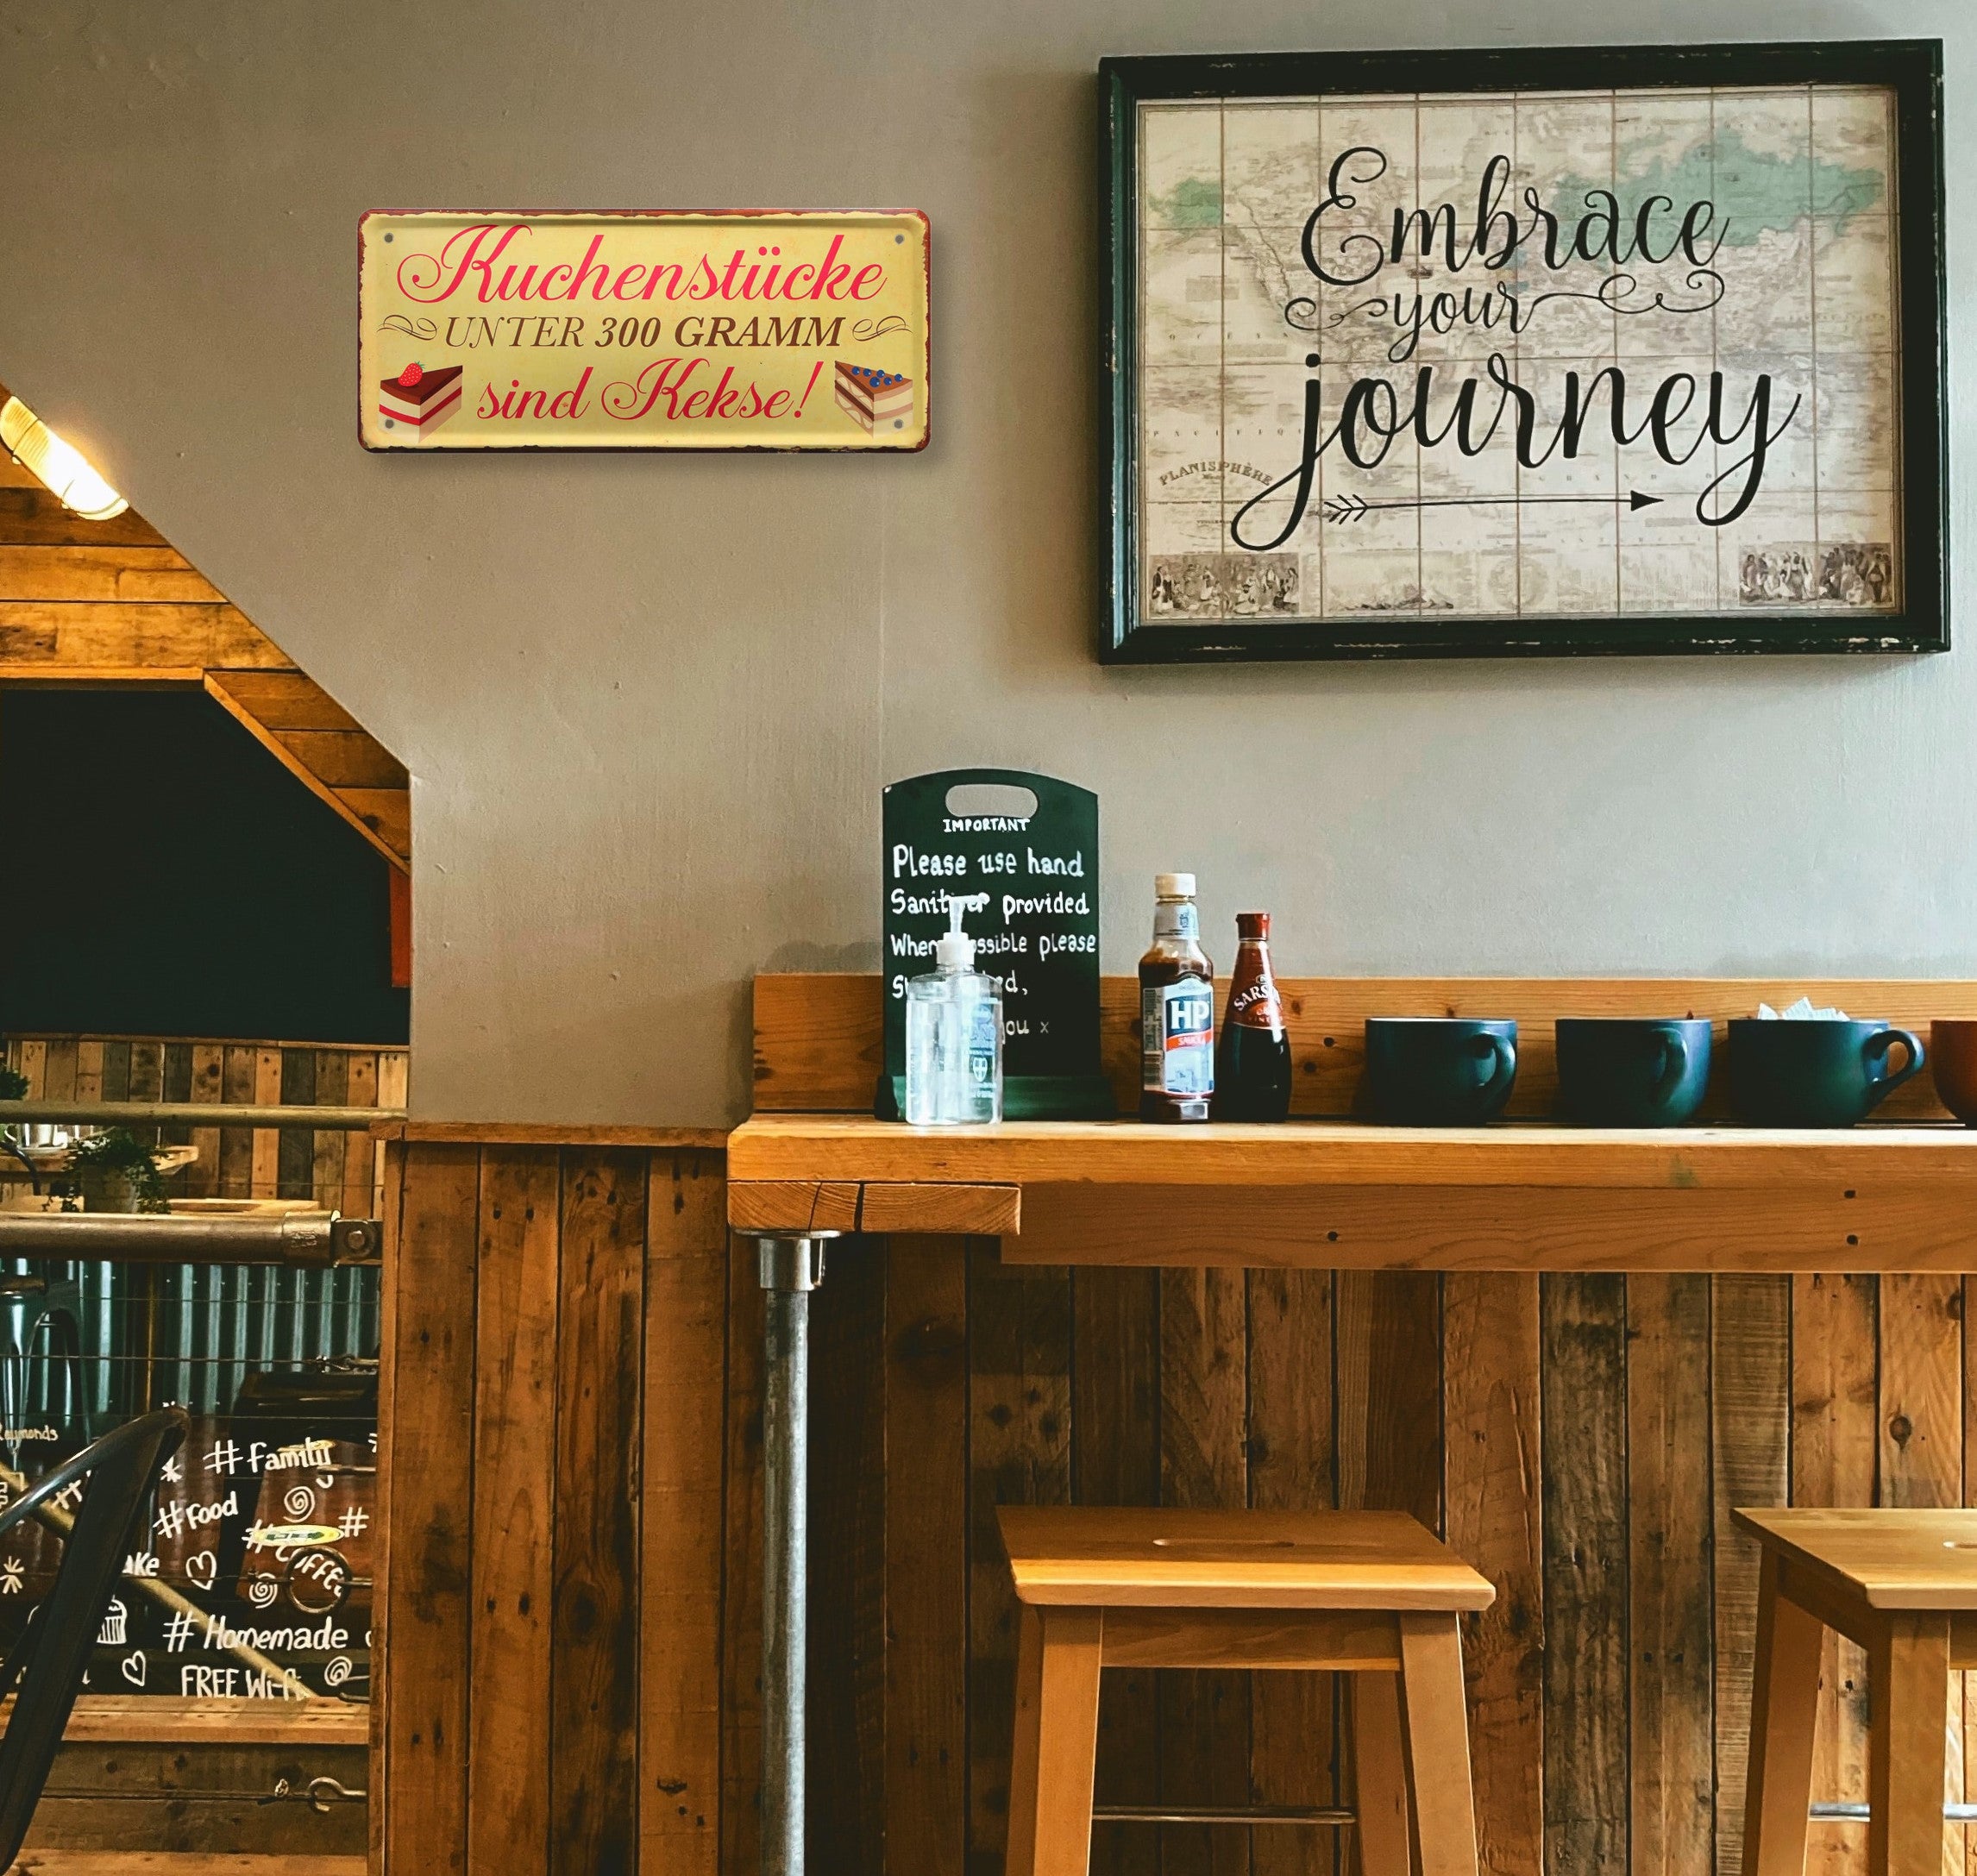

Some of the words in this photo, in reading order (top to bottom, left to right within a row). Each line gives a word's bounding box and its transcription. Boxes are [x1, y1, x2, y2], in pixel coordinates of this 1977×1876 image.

[1301, 146, 1730, 286] Embrace
[396, 224, 888, 304] Kuchenstücke
[445, 316, 587, 348] UNTER
[593, 316, 661, 348] 300
[674, 316, 846, 348] GRAMM
[1387, 280, 1537, 363] your
[476, 361, 593, 421] sind
[600, 357, 825, 421] Kekse!
[1230, 352, 1803, 552] journey
[1158, 460, 1274, 486] PLANISPHÈRE
[942, 818, 1031, 833] IMPORTANT
[893, 844, 967, 878] Please
[977, 852, 1018, 875] use
[1027, 846, 1085, 878] hand
[1002, 890, 1090, 925] provided
[1039, 932, 1096, 962] please
[1171, 1001, 1210, 1030] HP
[180, 1665, 240, 1699] FREE
